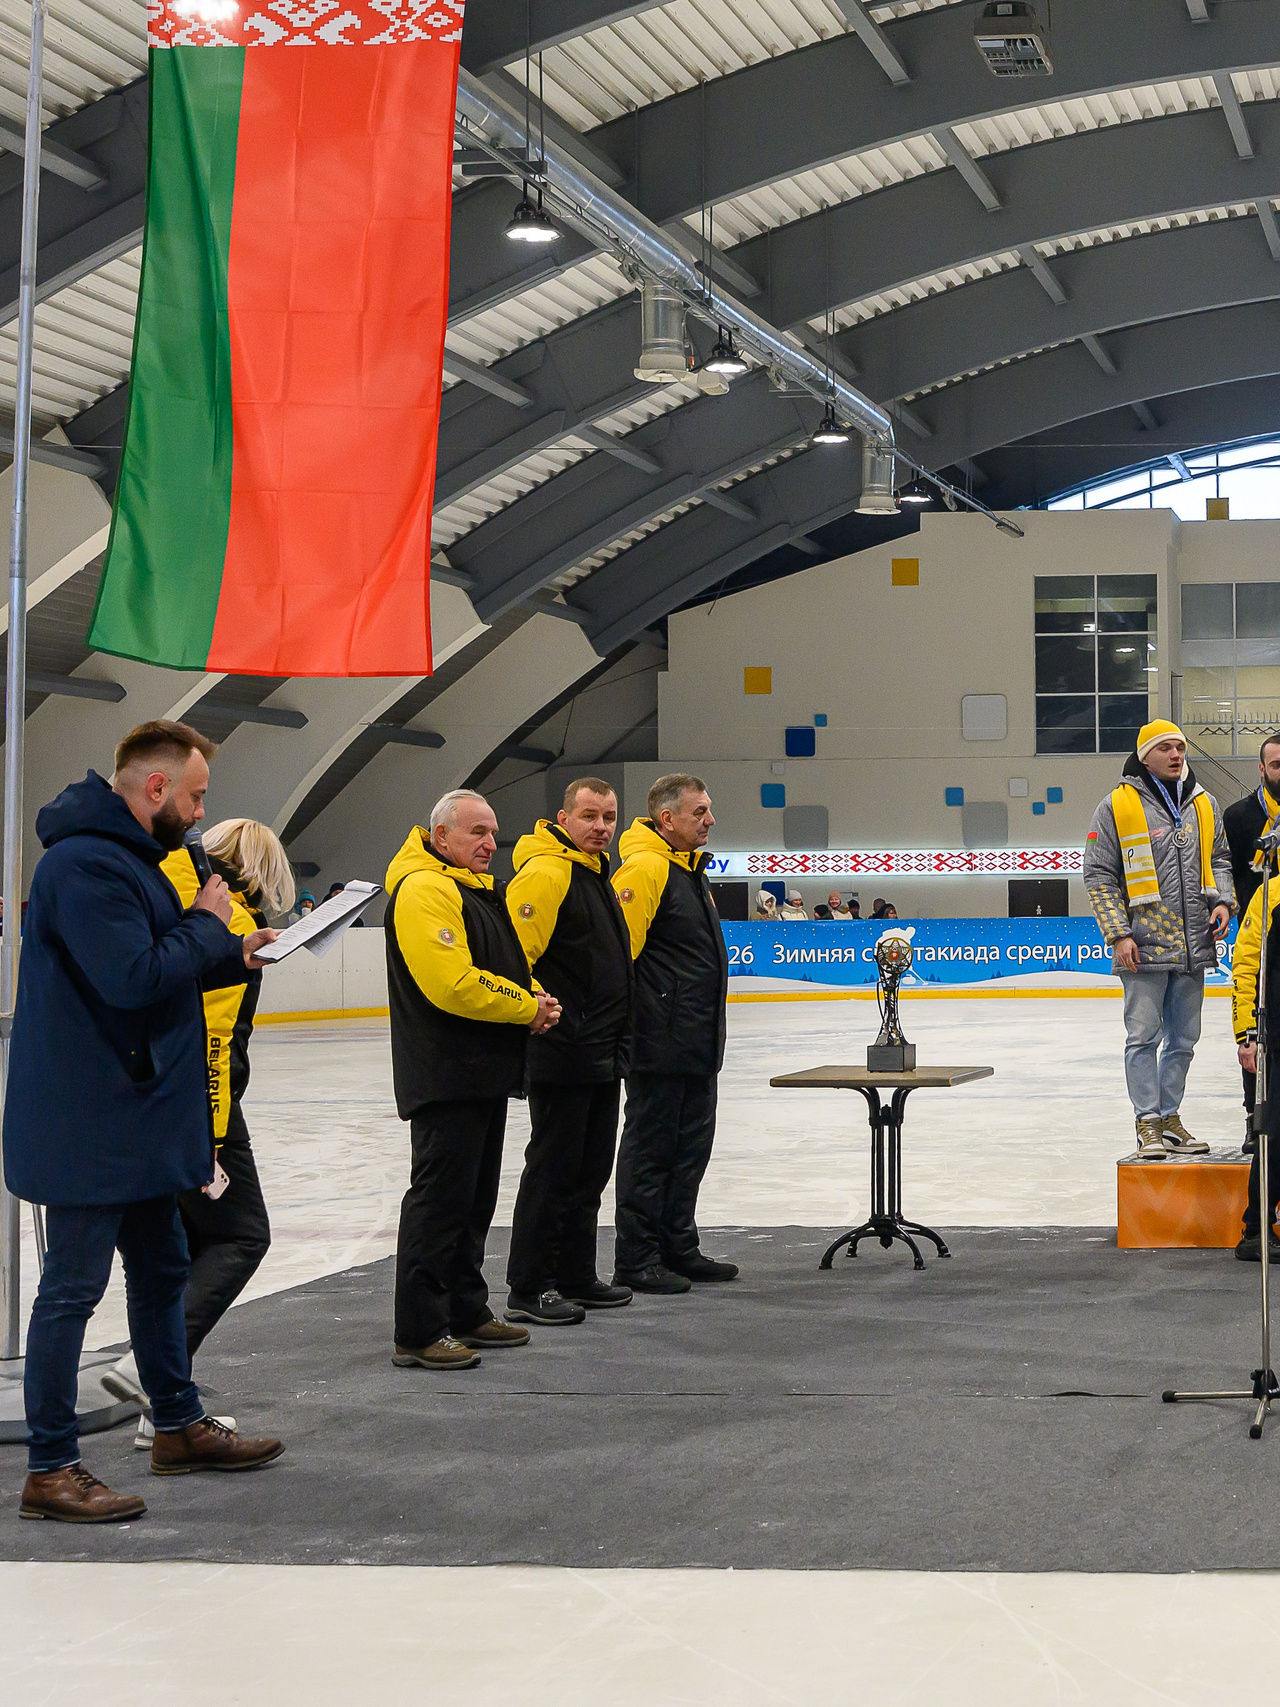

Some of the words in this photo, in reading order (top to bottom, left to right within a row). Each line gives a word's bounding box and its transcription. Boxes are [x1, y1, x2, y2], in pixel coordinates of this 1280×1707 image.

[772, 944, 856, 964] Зимняя
[1005, 944, 1072, 965] среди
[478, 975, 523, 1002] BELARUS
[208, 1037, 221, 1114] BELARUS
